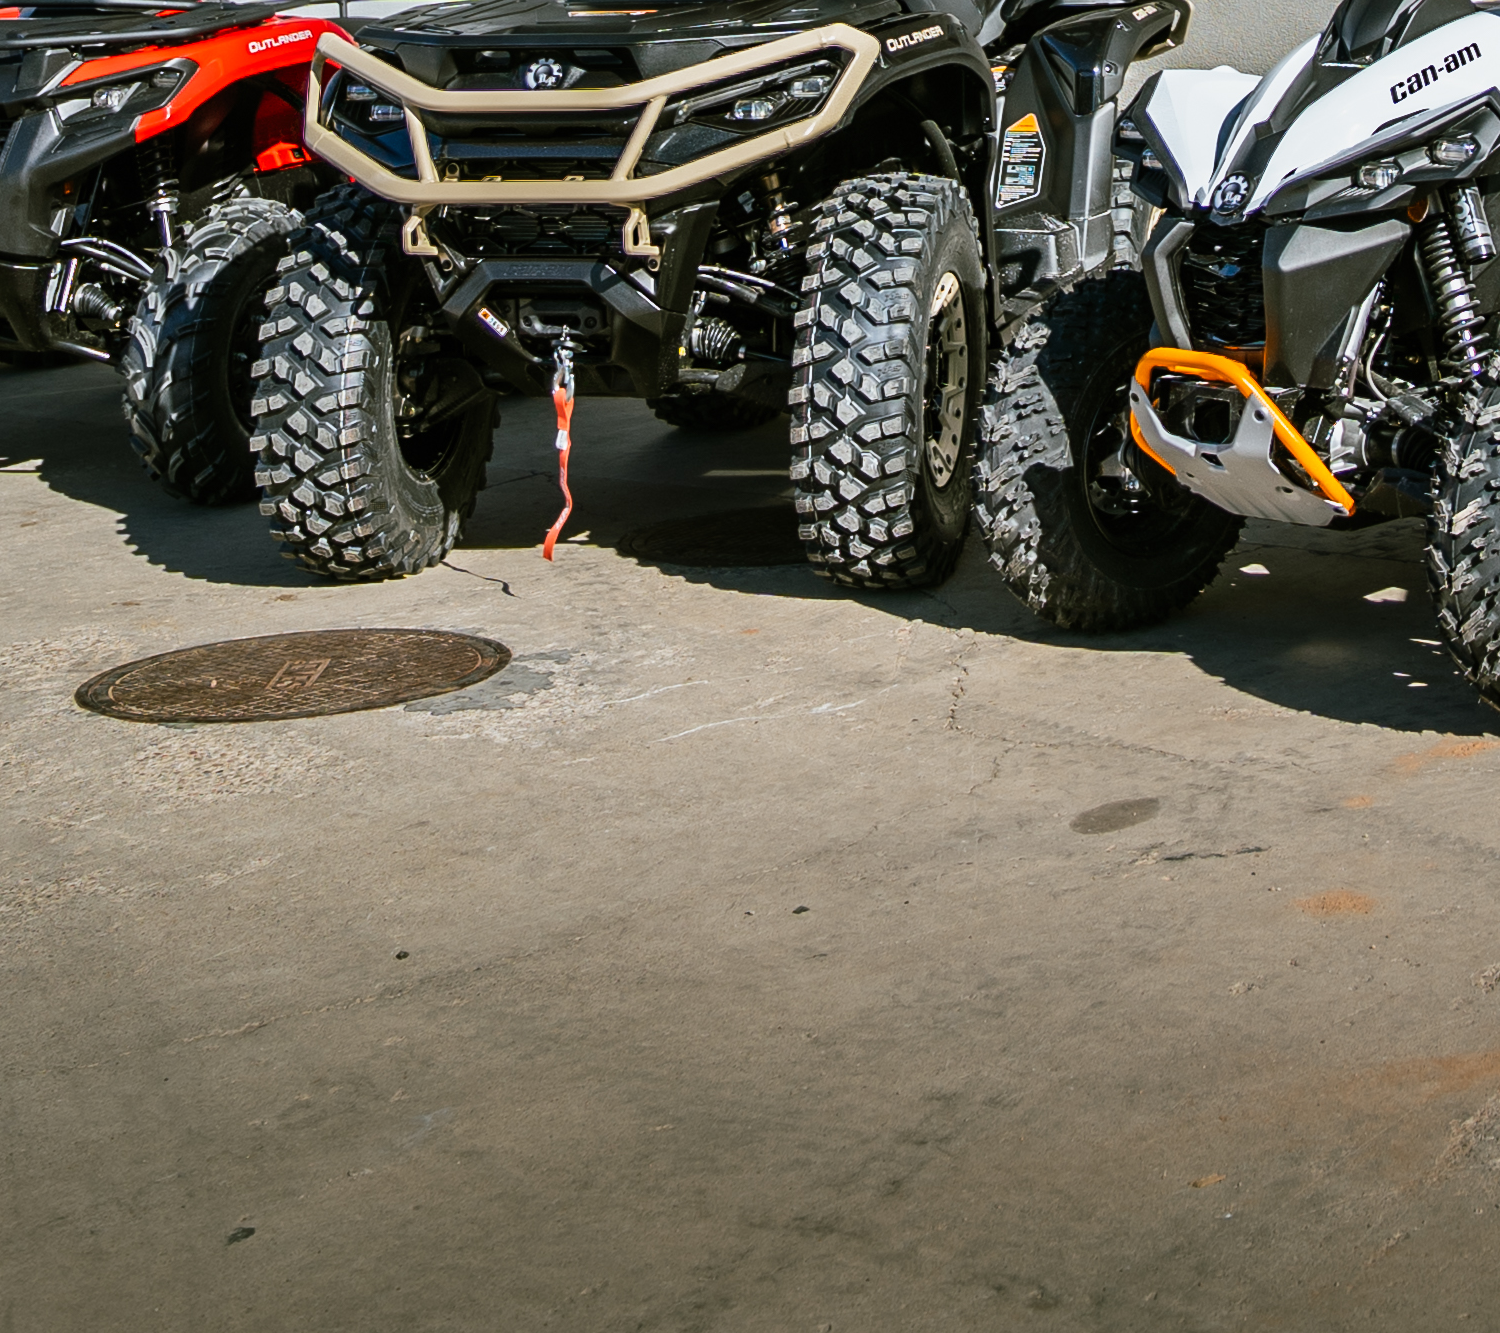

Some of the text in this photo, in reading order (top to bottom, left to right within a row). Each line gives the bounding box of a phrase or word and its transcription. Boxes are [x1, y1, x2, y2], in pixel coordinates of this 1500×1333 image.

[248, 29, 314, 54] OUTLANDER
[885, 24, 945, 52] OUTLANDER
[1389, 42, 1482, 105] can-am
